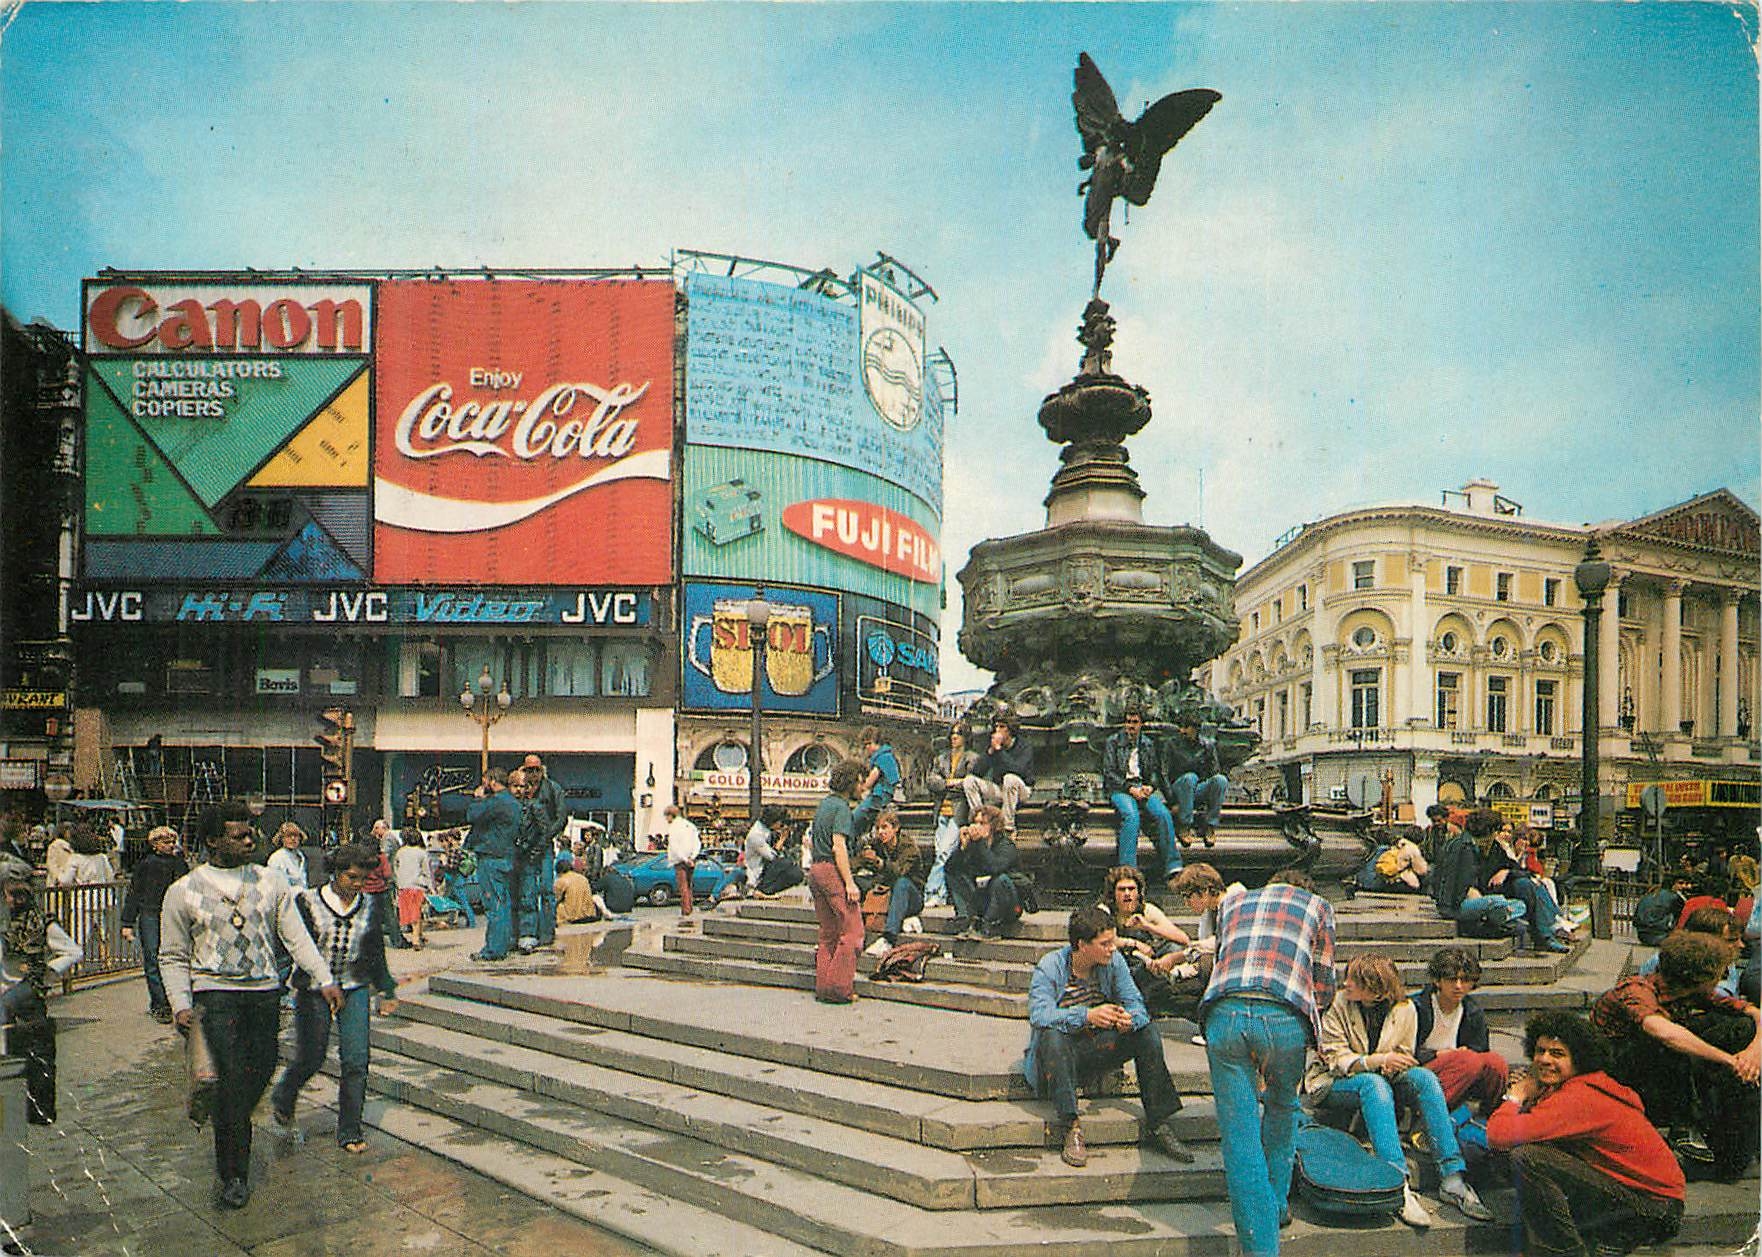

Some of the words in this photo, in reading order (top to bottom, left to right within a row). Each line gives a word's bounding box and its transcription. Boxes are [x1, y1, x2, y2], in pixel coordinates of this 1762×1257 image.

[89, 285, 363, 350] Canon
[132, 360, 283, 379] CALCULATORS
[469, 367, 522, 388] Enjoy
[132, 380, 236, 399] CAMERAS
[132, 400, 225, 418] COPIERS
[394, 380, 651, 460] Coca-Cola
[812, 503, 891, 556] FUJI
[71, 592, 142, 621] JVC
[313, 591, 388, 622] JVC
[561, 592, 636, 623] JVC
[708, 774, 745, 786] GOLD
